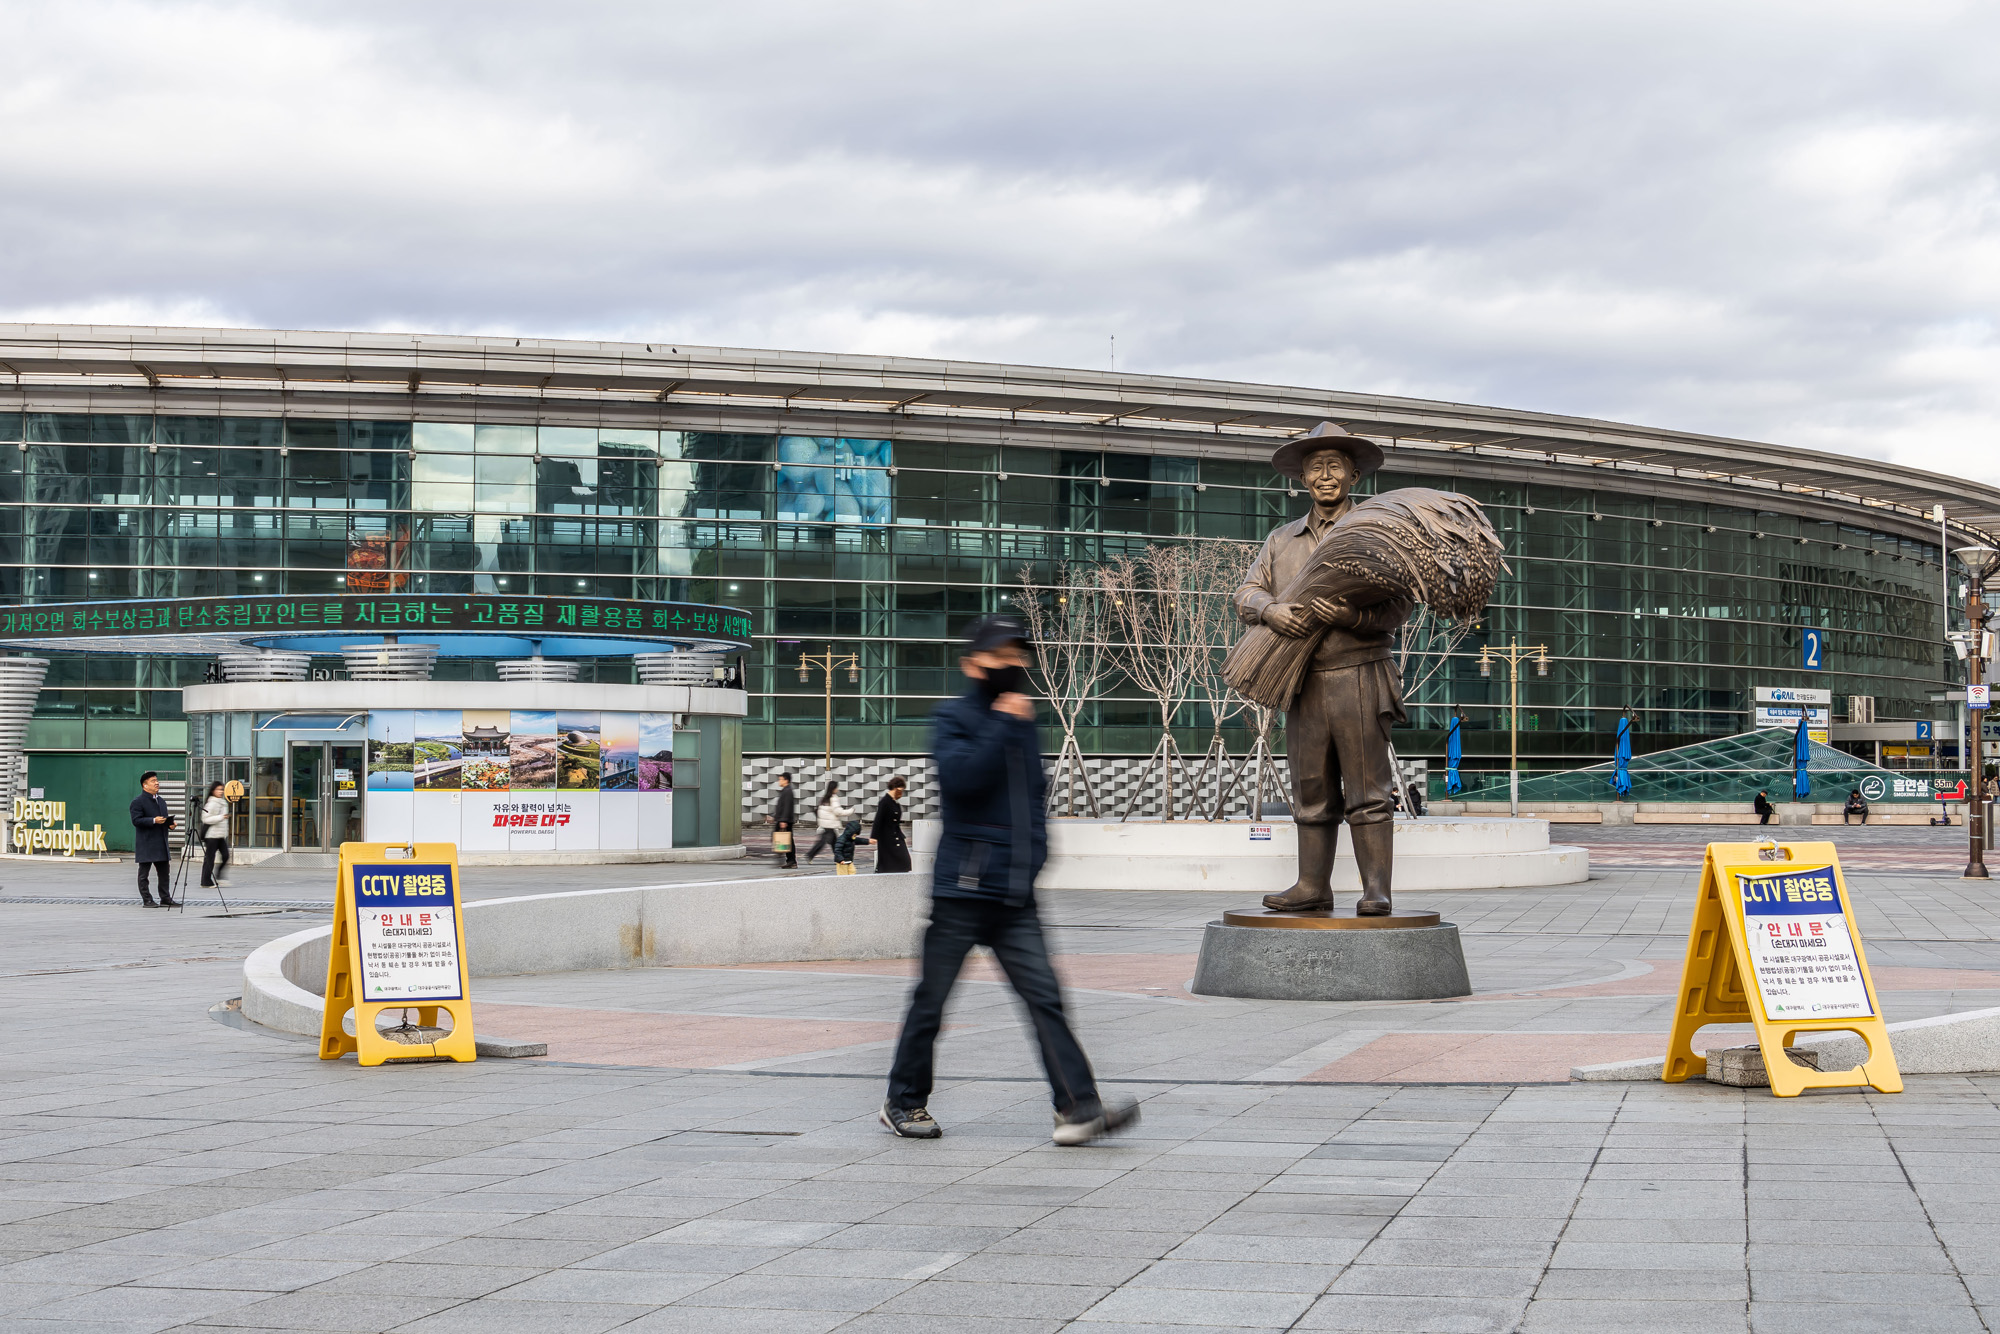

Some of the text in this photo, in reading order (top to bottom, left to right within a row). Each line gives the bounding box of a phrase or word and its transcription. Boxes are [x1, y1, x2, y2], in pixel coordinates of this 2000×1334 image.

[2, 611, 64, 633] 가져오면
[72, 606, 170, 631] 회수보상금과
[179, 603, 343, 627] 탄소중립포인트를
[355, 602, 453, 624] 지급하는
[557, 604, 643, 629] 재활용품
[1807, 632, 1818, 666] 2
[1771, 689, 1795, 700] KORAIL
[1920, 724, 1928, 737] 2
[1893, 779, 1928, 792] 흡연실
[1935, 779, 1953, 788] 55m
[14, 797, 65, 827] Daegu
[493, 804, 571, 812] 자유와 활력이 넘치는
[493, 814, 570, 827] 파워풀 대구
[13, 823, 107, 856] Gyeongbuk
[361, 875, 446, 896] CCTV 촬영중
[1744, 878, 1833, 902] CCTV 촬영중
[382, 927, 432, 936] (손대지 마세요)
[1771, 938, 1826, 948] (손대지 마세요)
